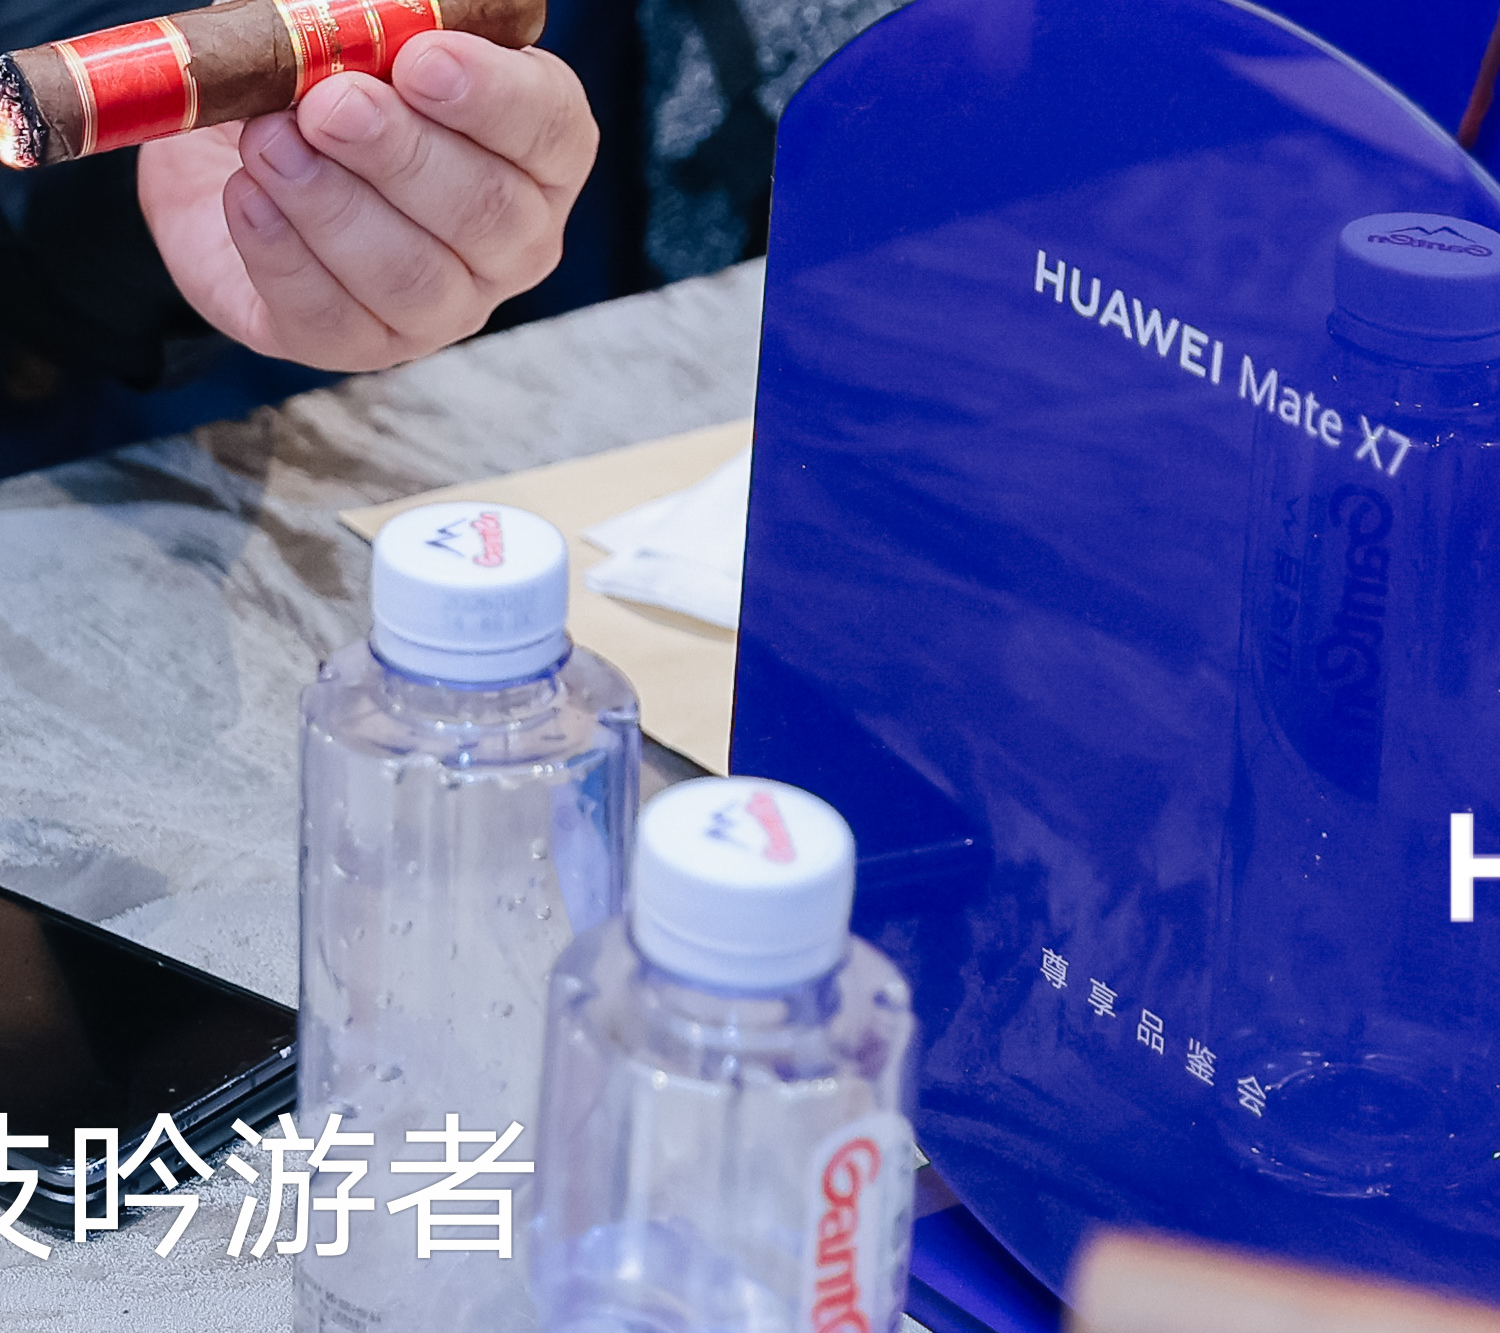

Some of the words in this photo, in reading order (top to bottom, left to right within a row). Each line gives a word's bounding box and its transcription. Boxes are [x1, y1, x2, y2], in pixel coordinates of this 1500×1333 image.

[1033, 249, 1225, 386] HUAWEI
[1238, 354, 1343, 447] Mate
[1355, 415, 1411, 477] X7
[1040, 946, 1267, 1117] 尊享品鉴会
[811, 1136, 883, 1333] Gant
